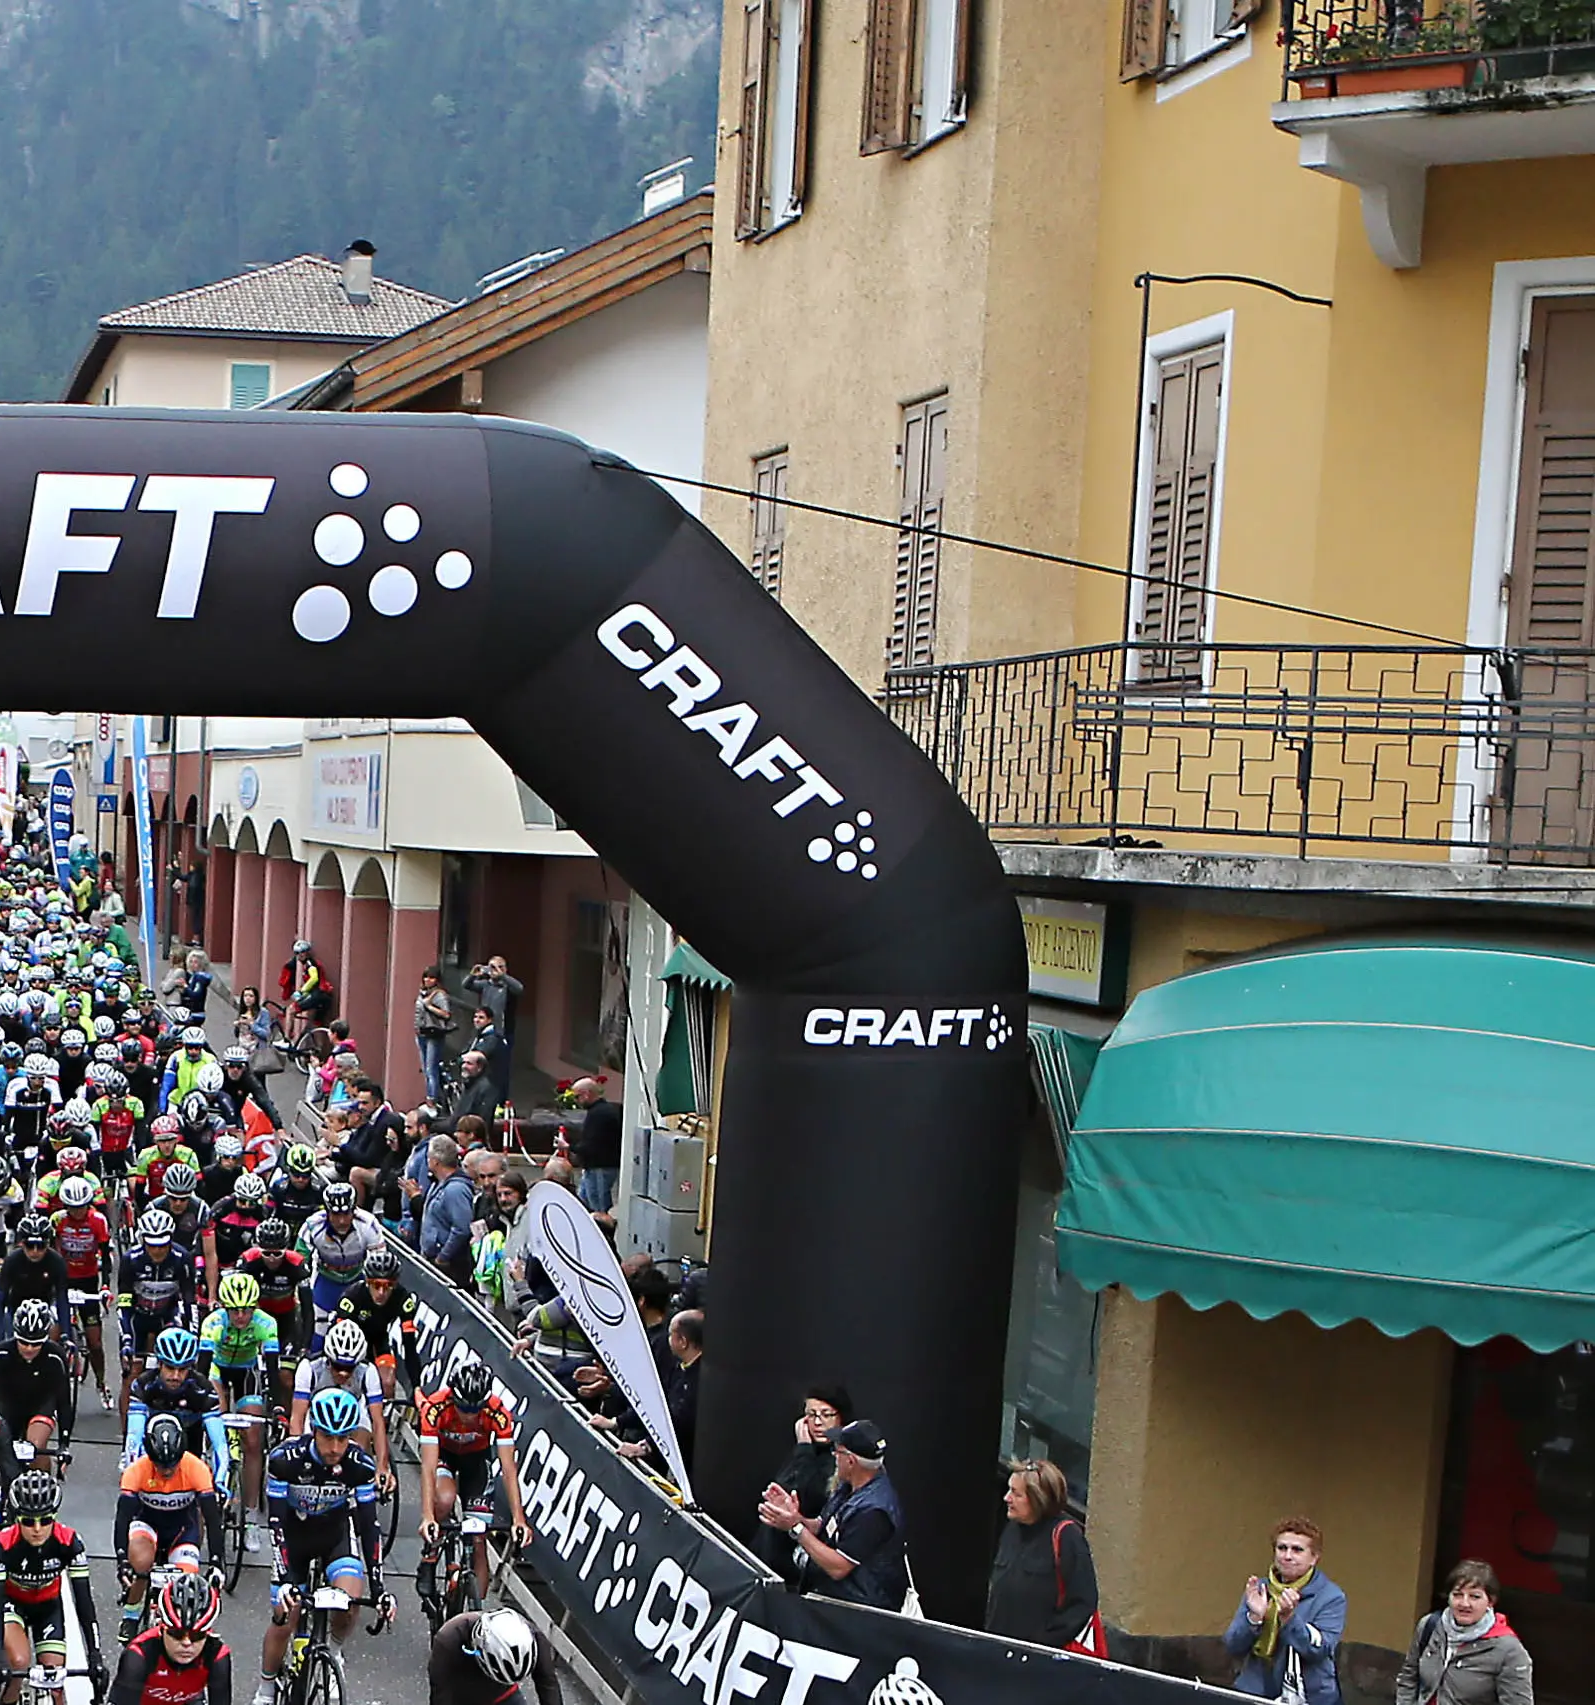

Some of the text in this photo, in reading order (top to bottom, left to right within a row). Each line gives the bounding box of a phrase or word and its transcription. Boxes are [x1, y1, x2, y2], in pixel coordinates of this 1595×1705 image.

[596, 602, 845, 819] CRAFT
[803, 1007, 985, 1047] CRAFT
[516, 1427, 624, 1582] CRAFT
[633, 1555, 861, 1705] CRAFT
